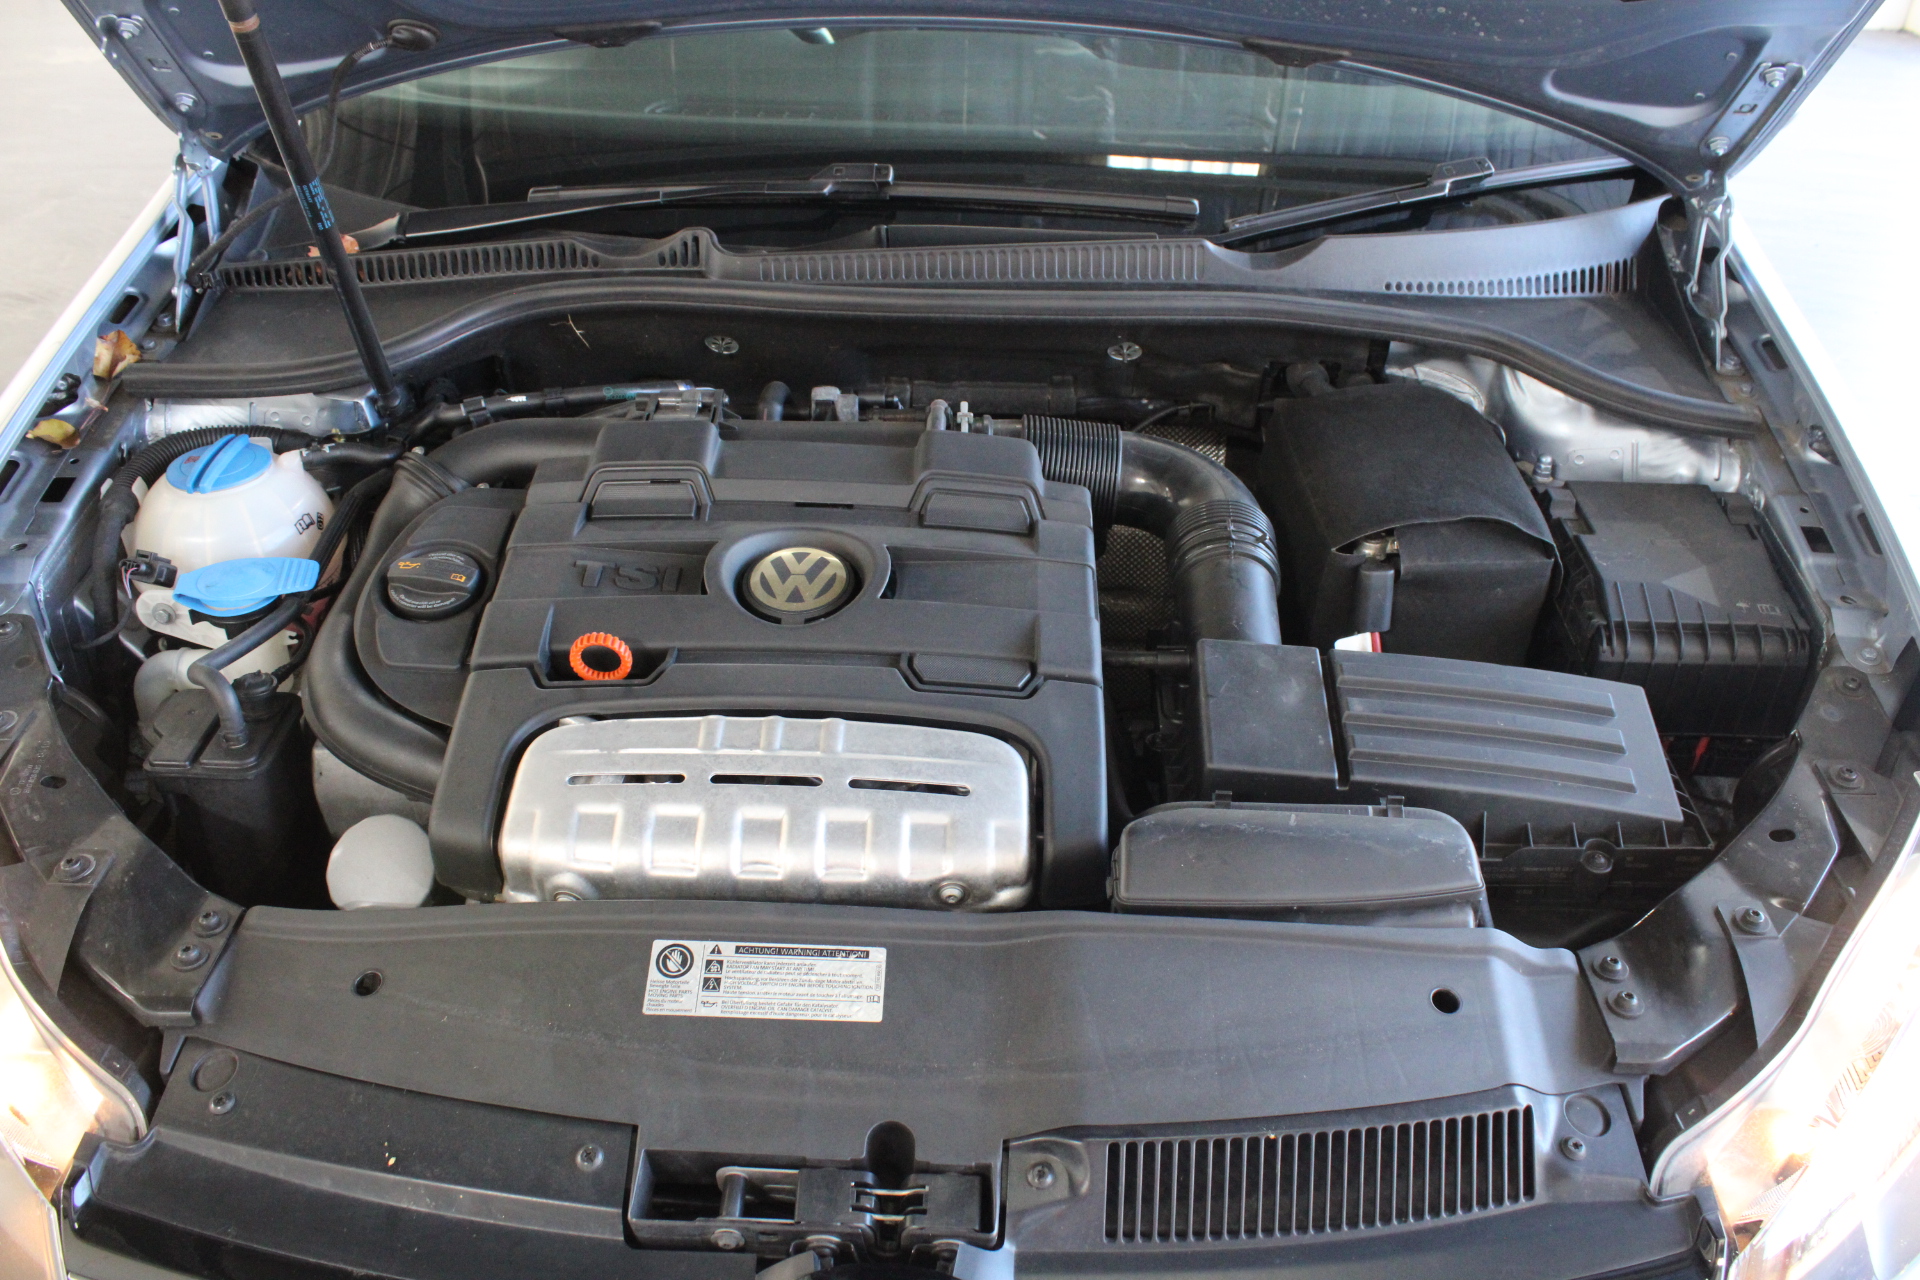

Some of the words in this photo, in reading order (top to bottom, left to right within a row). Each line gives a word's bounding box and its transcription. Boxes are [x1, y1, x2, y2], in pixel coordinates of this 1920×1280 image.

[574, 560, 682, 592] TSI
[750, 547, 847, 612] VW
[822, 950, 867, 958] ATTENTION!
